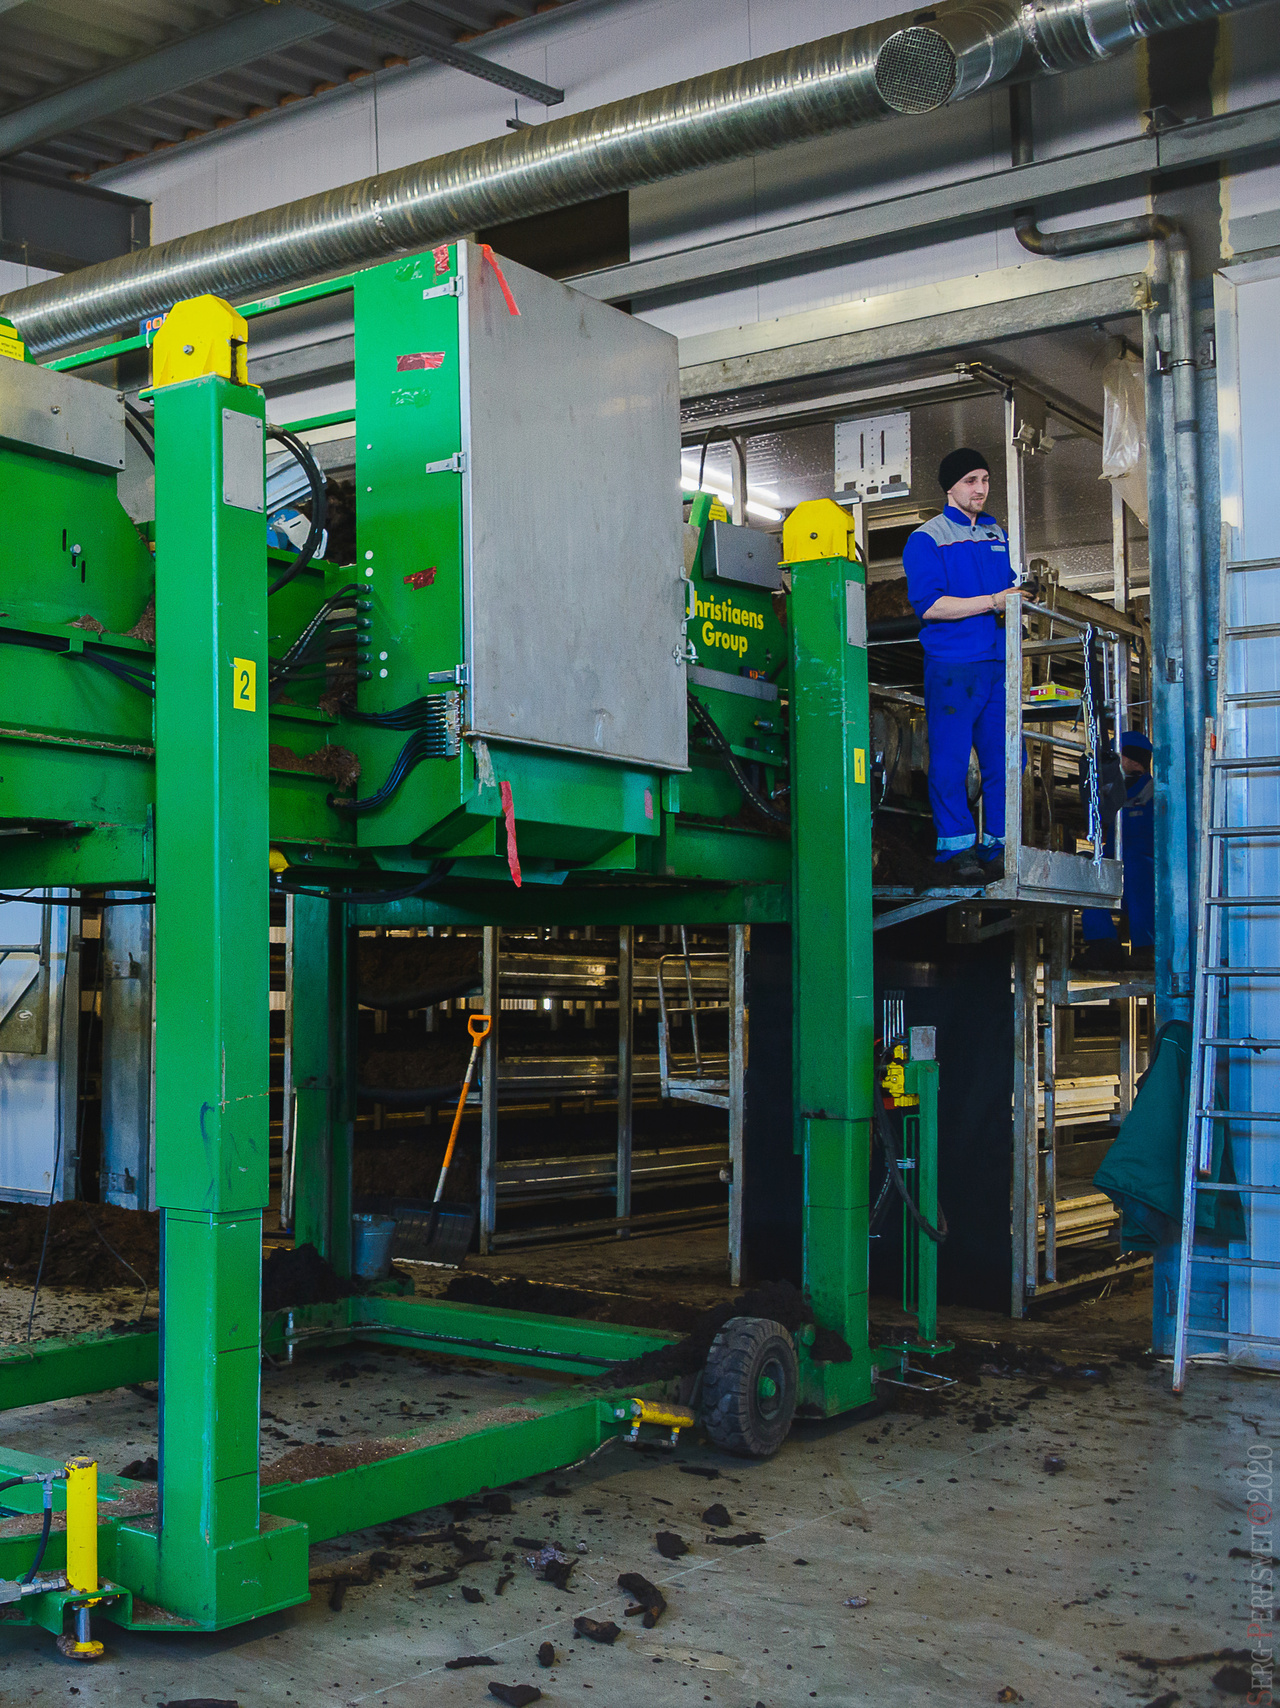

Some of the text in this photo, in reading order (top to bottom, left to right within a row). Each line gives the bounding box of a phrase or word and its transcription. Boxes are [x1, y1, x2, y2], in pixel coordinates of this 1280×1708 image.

[686, 590, 765, 630] hristiaens
[702, 620, 748, 659] Group
[240, 670, 250, 701] 2
